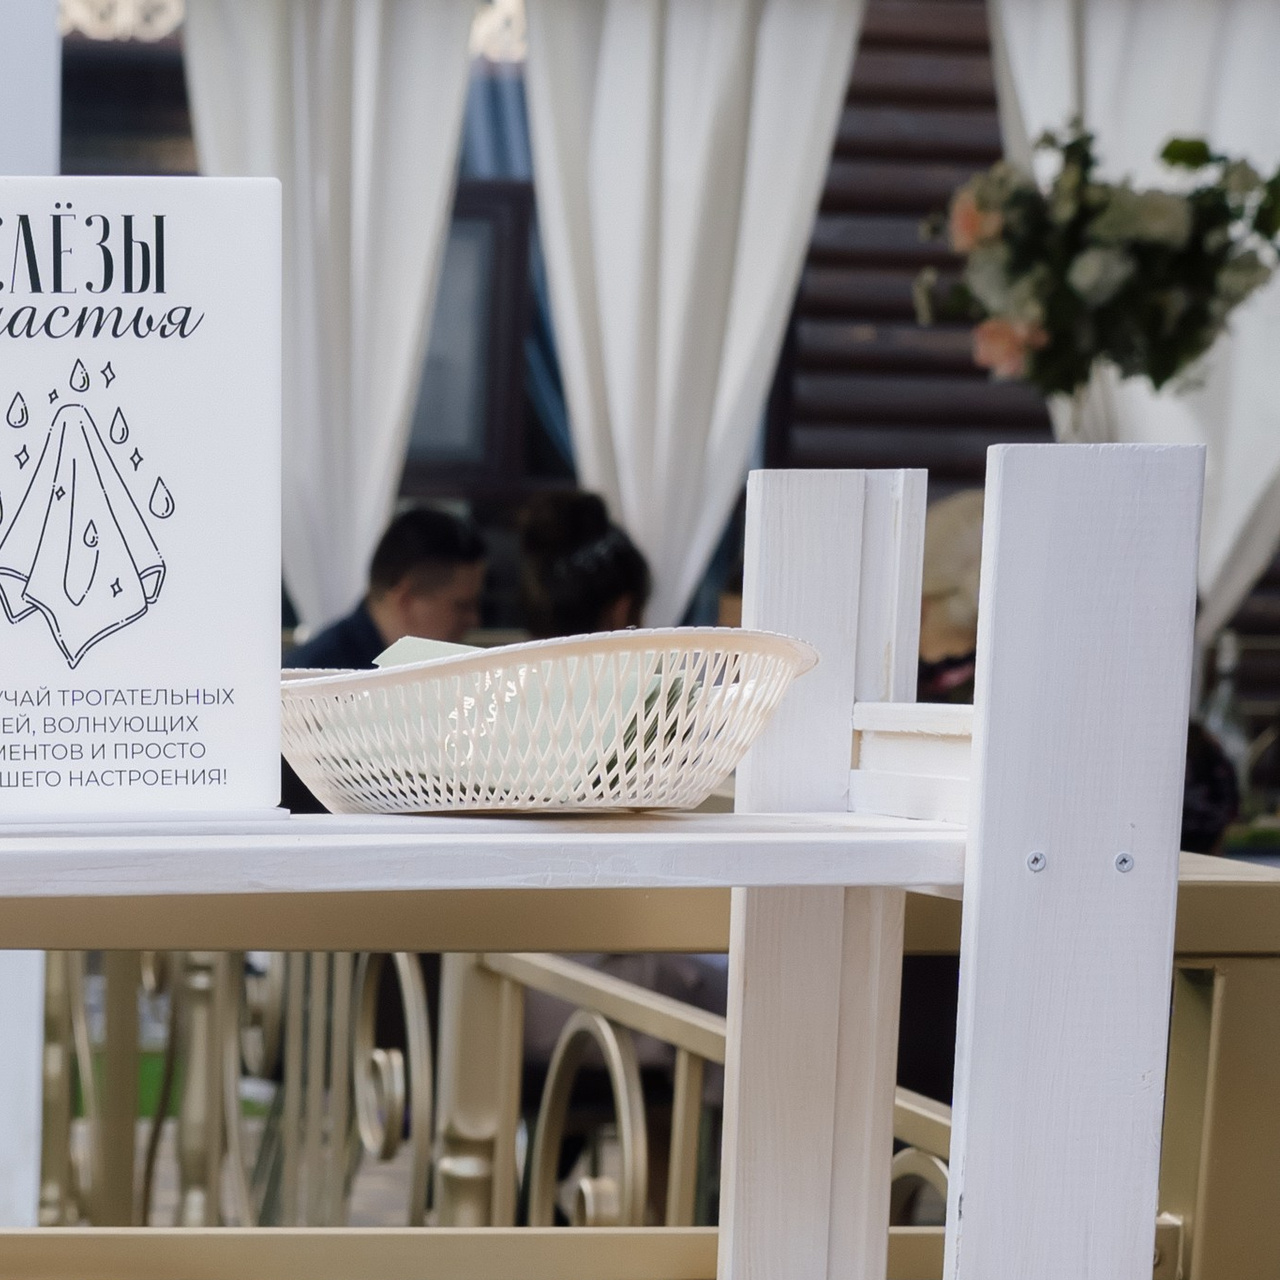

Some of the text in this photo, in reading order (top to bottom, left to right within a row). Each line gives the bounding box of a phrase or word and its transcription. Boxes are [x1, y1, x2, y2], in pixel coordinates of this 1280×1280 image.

[57, 688, 235, 706] ТРОГАТЕЛЬНЫХ
[43, 715, 199, 735] ВОЛНУЮЩИХ
[91, 743, 106, 759] И
[114, 742, 207, 759] ПРОСТО
[69, 769, 228, 787] НАСТРОЕНИЯ!
